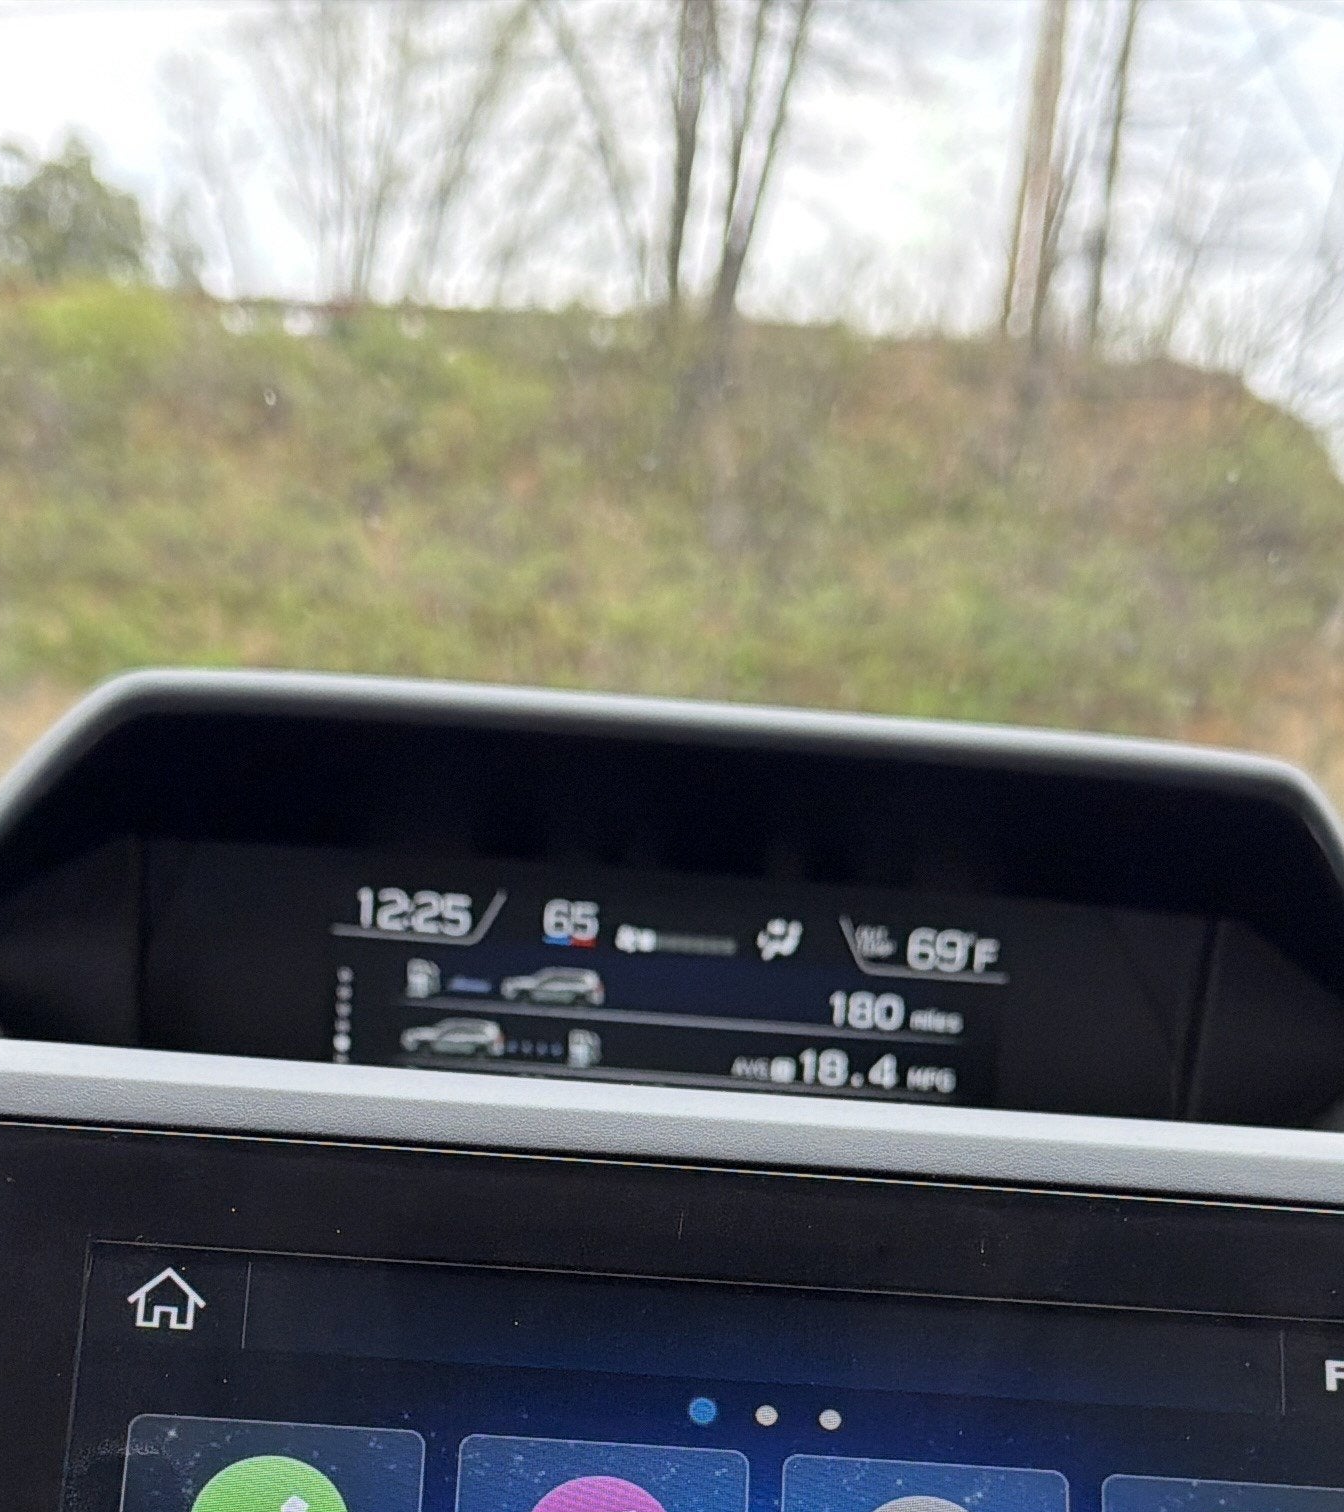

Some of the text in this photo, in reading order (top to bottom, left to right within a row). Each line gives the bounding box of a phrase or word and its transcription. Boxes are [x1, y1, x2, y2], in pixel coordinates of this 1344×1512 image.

[543, 899, 599, 940] 65
[830, 990, 905, 1030] 180
[800, 1048, 897, 1089] 18.4
